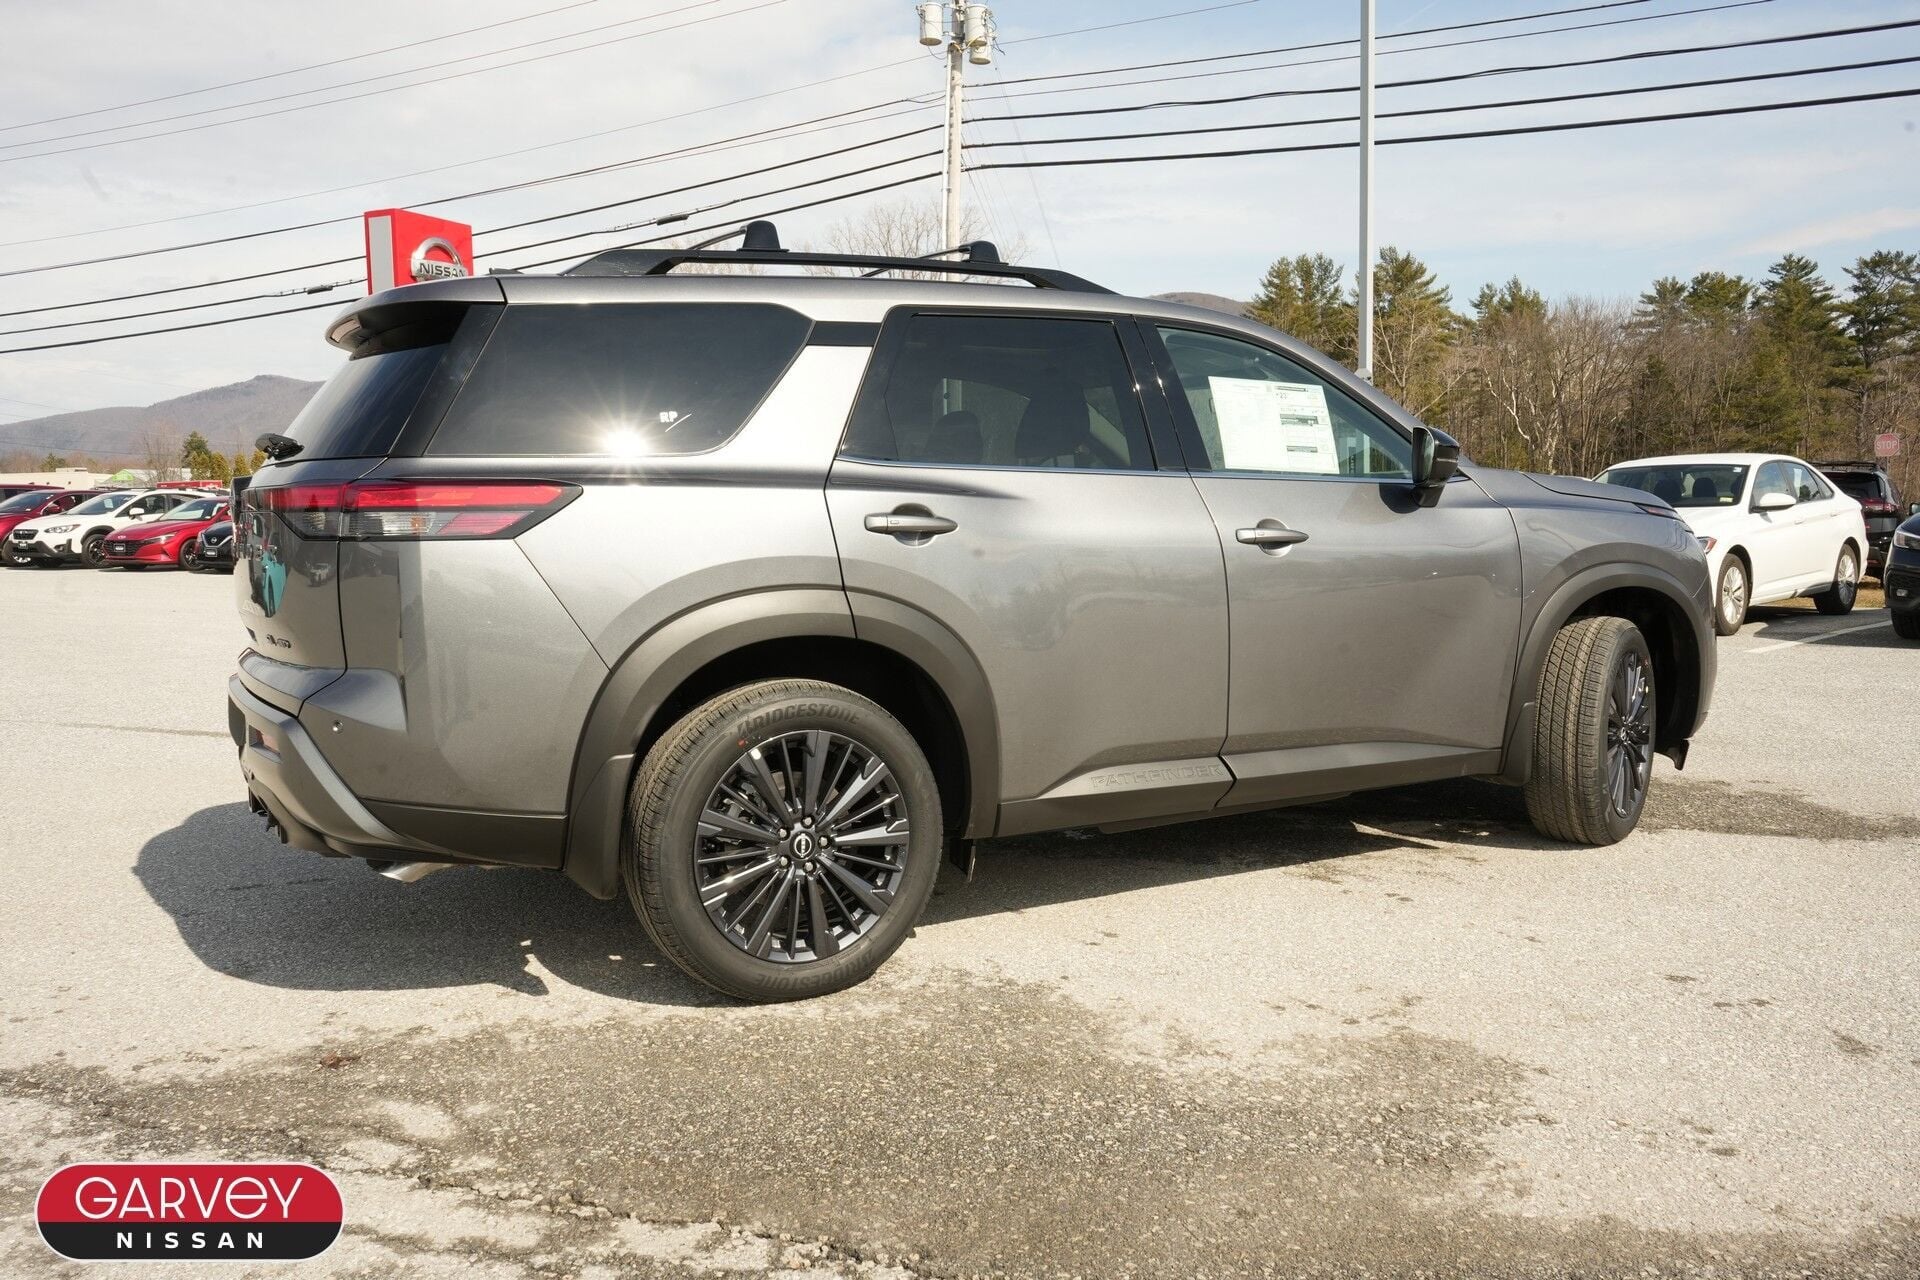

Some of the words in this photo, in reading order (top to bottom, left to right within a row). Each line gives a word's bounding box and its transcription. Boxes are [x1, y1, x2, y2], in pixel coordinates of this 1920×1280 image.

[419, 261, 466, 278] NISSAN
[1876, 440, 1898, 450] STOP
[737, 703, 860, 737] BRIDGESTONE
[1090, 764, 1224, 788] PATHFINDER
